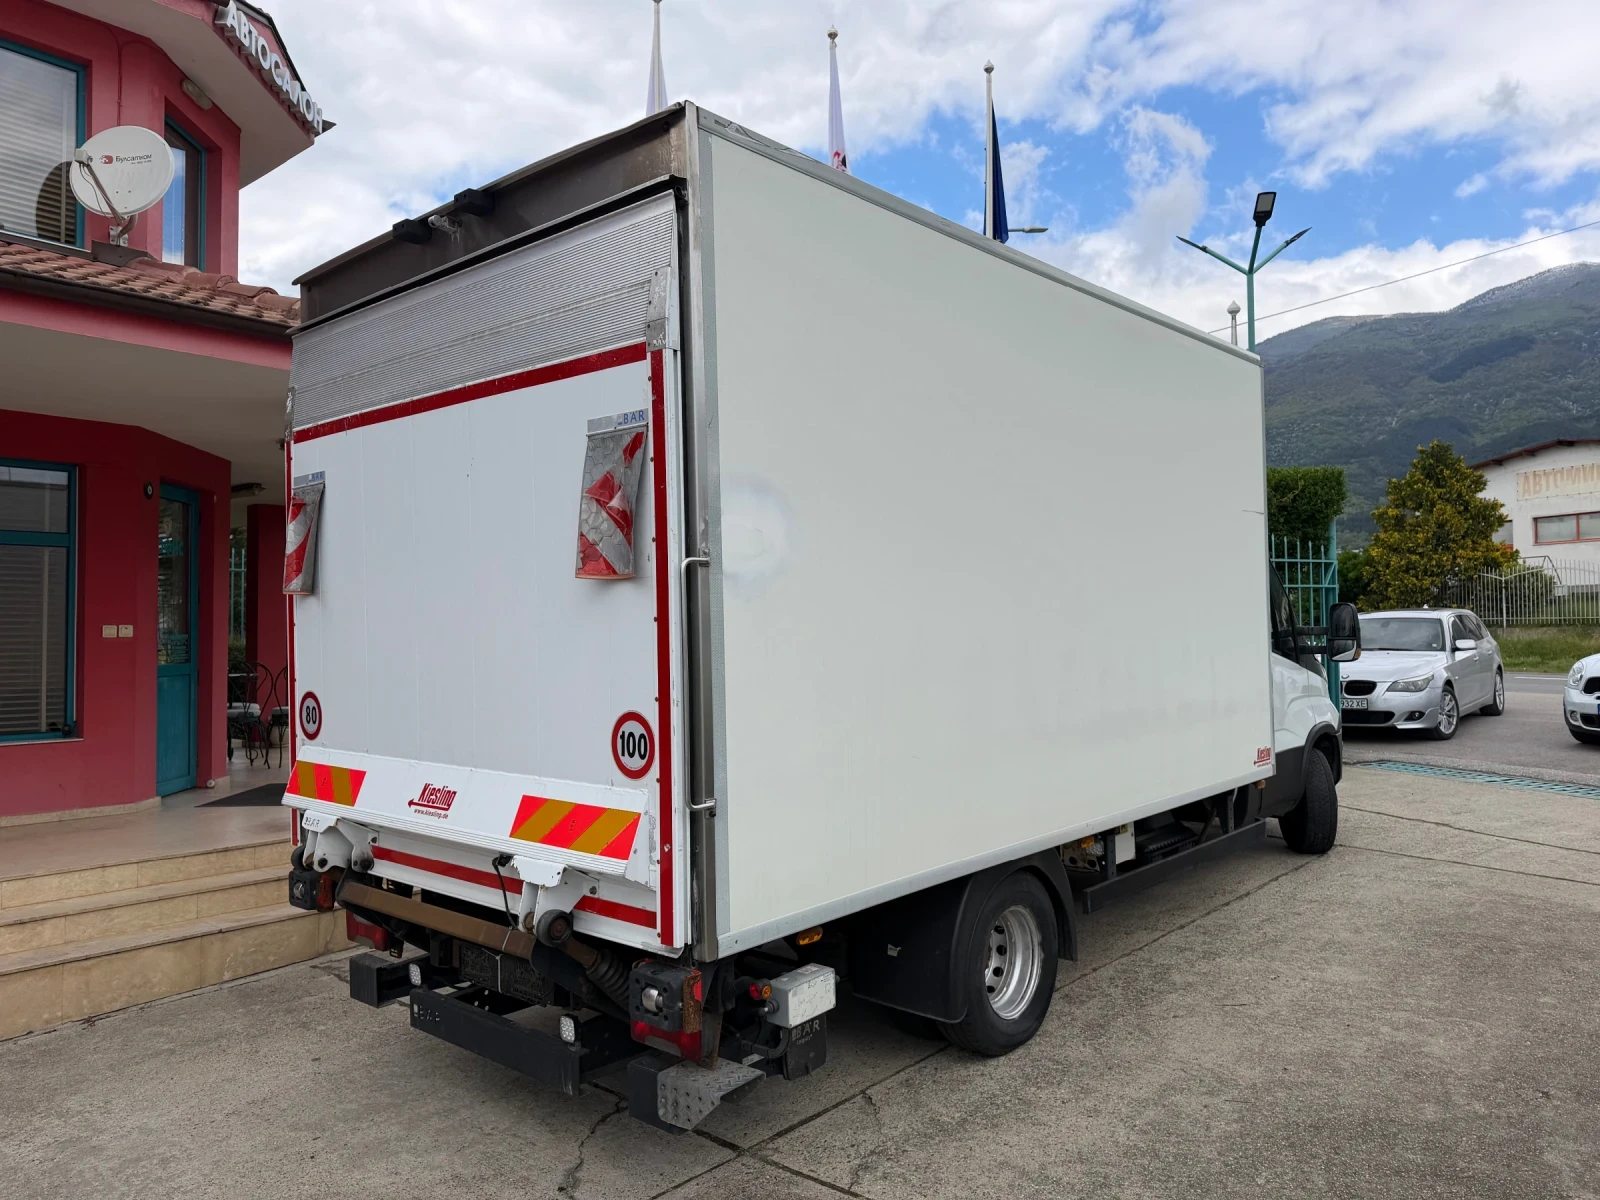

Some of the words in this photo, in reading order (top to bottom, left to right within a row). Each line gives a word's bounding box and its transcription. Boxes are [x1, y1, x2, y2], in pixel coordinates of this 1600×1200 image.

[220, 0, 322, 134] АВТОСАЛОН
[1521, 464, 1600, 498] АВТОМИ
[305, 705, 318, 725] 80
[619, 730, 648, 761] 100
[418, 782, 457, 811] Kiesling
[414, 808, 449, 820] www.kiesling.de
